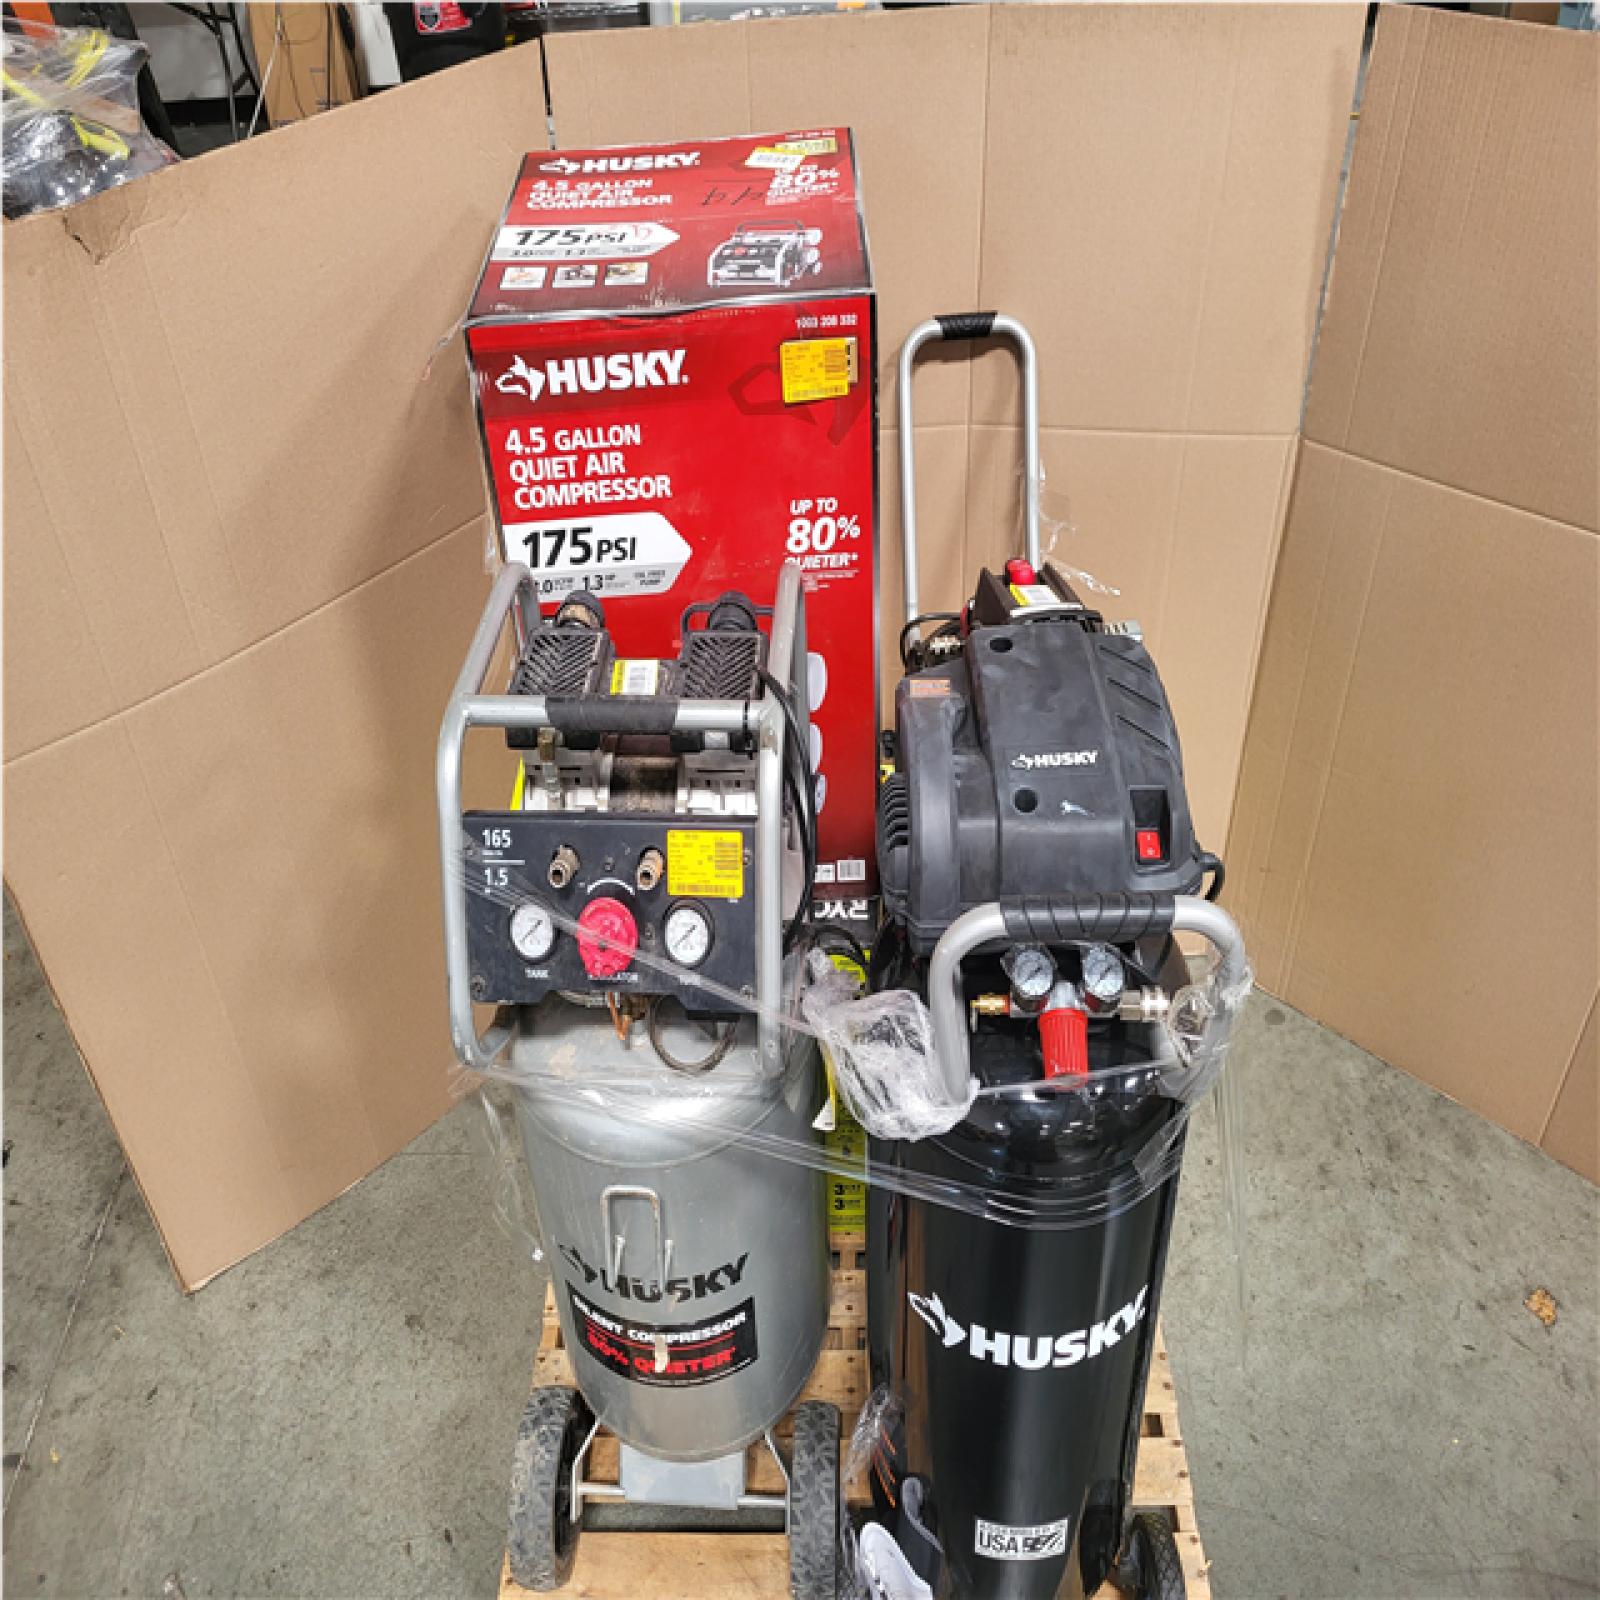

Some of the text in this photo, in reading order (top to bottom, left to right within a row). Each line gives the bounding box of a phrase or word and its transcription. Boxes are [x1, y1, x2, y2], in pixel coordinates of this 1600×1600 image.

[532, 179, 653, 191] 4.5 GALLON
[527, 195, 672, 210] COMPRESSOR
[529, 189, 634, 201] QUIET AIR
[517, 228, 627, 246] 175 PSI
[505, 424, 641, 454] 4.5 GALLON
[509, 452, 625, 486] QUIET AIR
[515, 475, 671, 509] COMPRESSOR
[790, 497, 839, 515] UP TO
[785, 515, 860, 554] 80%
[522, 527, 636, 568] 175 PSI
[583, 575, 603, 591] 1.3
[1034, 750, 1098, 768] HUSKY
[482, 829, 511, 848] 165
[484, 868, 508, 886] 1.5
[600, 1252, 749, 1303] HUSKY
[969, 1284, 1148, 1370] HUSKY
[979, 1530, 1018, 1553] USA
